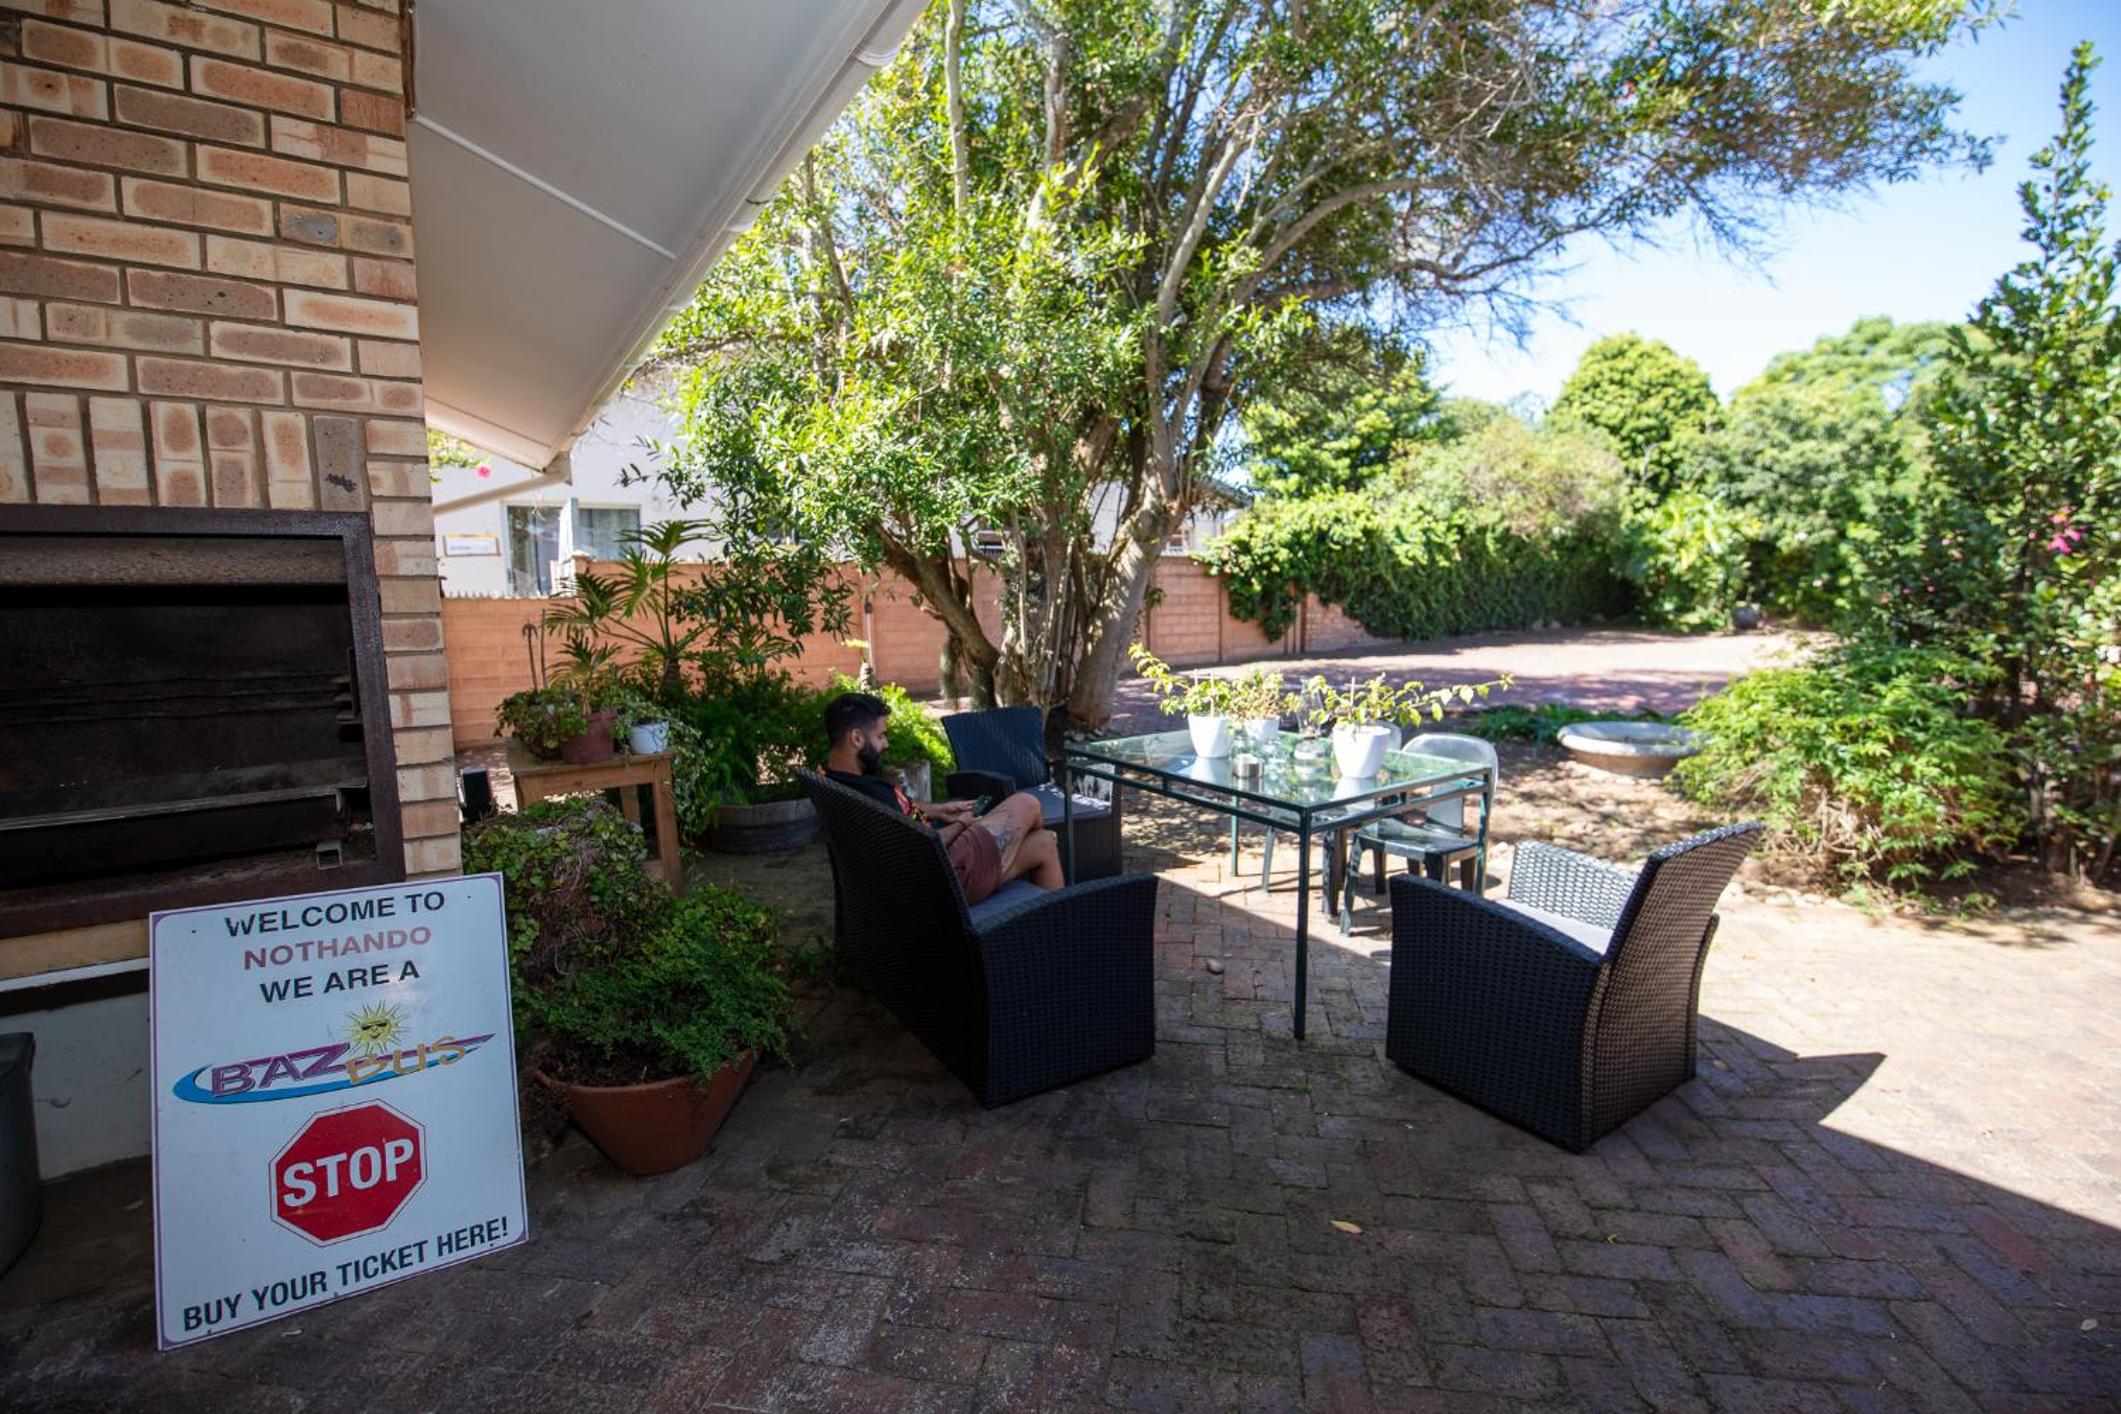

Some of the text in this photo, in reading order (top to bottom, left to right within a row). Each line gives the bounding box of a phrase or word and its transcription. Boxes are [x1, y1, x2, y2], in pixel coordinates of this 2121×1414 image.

[225, 890, 446, 938] WELCOME TO
[244, 926, 432, 970] NOTHANDO
[260, 960, 420, 1003] WE ARE A
[211, 1035, 467, 1097] BAZ BUS
[283, 1138, 414, 1208] STOP
[183, 1217, 509, 1332] BUY YOUR TICKET HERE!
